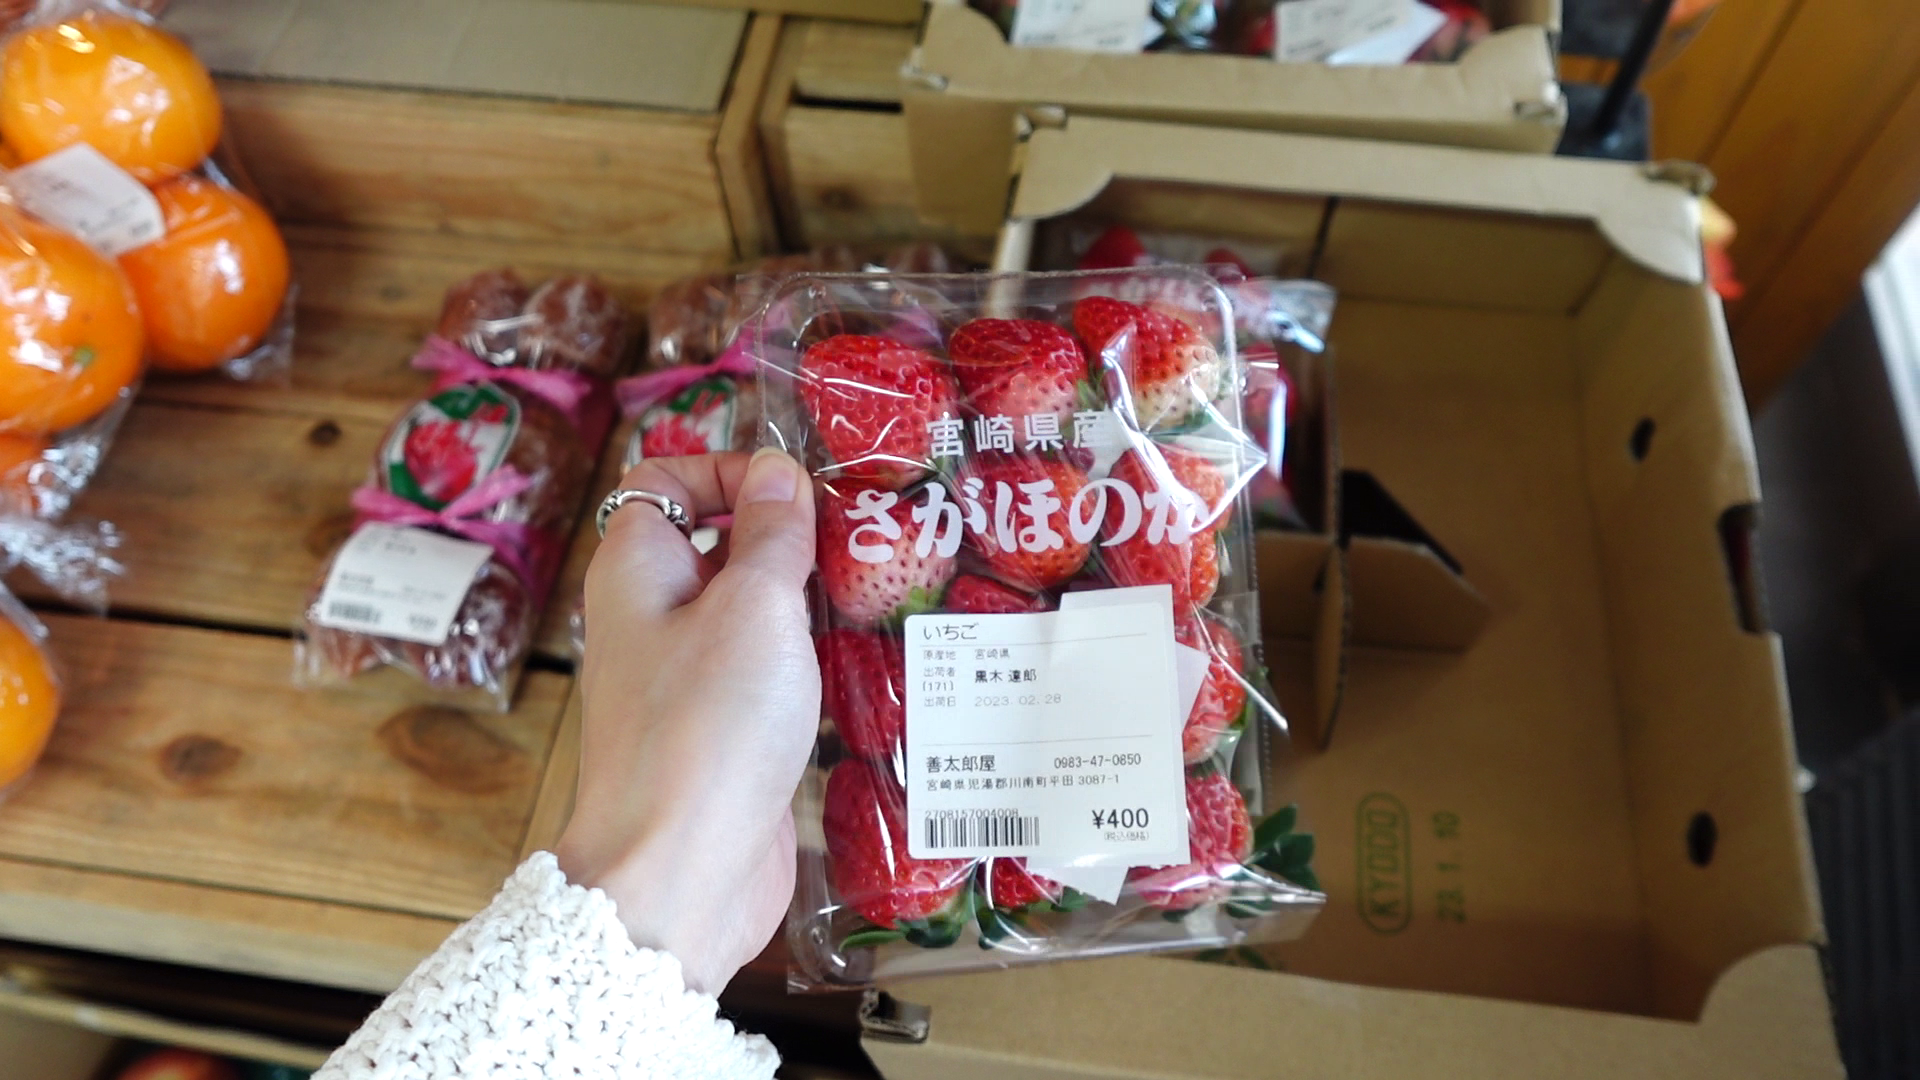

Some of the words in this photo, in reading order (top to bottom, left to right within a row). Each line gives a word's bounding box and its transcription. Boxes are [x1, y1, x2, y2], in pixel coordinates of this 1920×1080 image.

[926, 411, 1112, 458] 宮崎県産
[923, 623, 979, 641] いちご
[922, 649, 956, 661] 原産地
[974, 648, 1010, 660] 宮崎県
[923, 666, 956, 678] 出荷者
[974, 669, 1004, 684] 黒木
[923, 696, 956, 708] 出荷日
[926, 754, 997, 774] 善太郎屋
[1053, 752, 1142, 770] 0983-47-0850
[1092, 808, 1149, 829] ¥400
